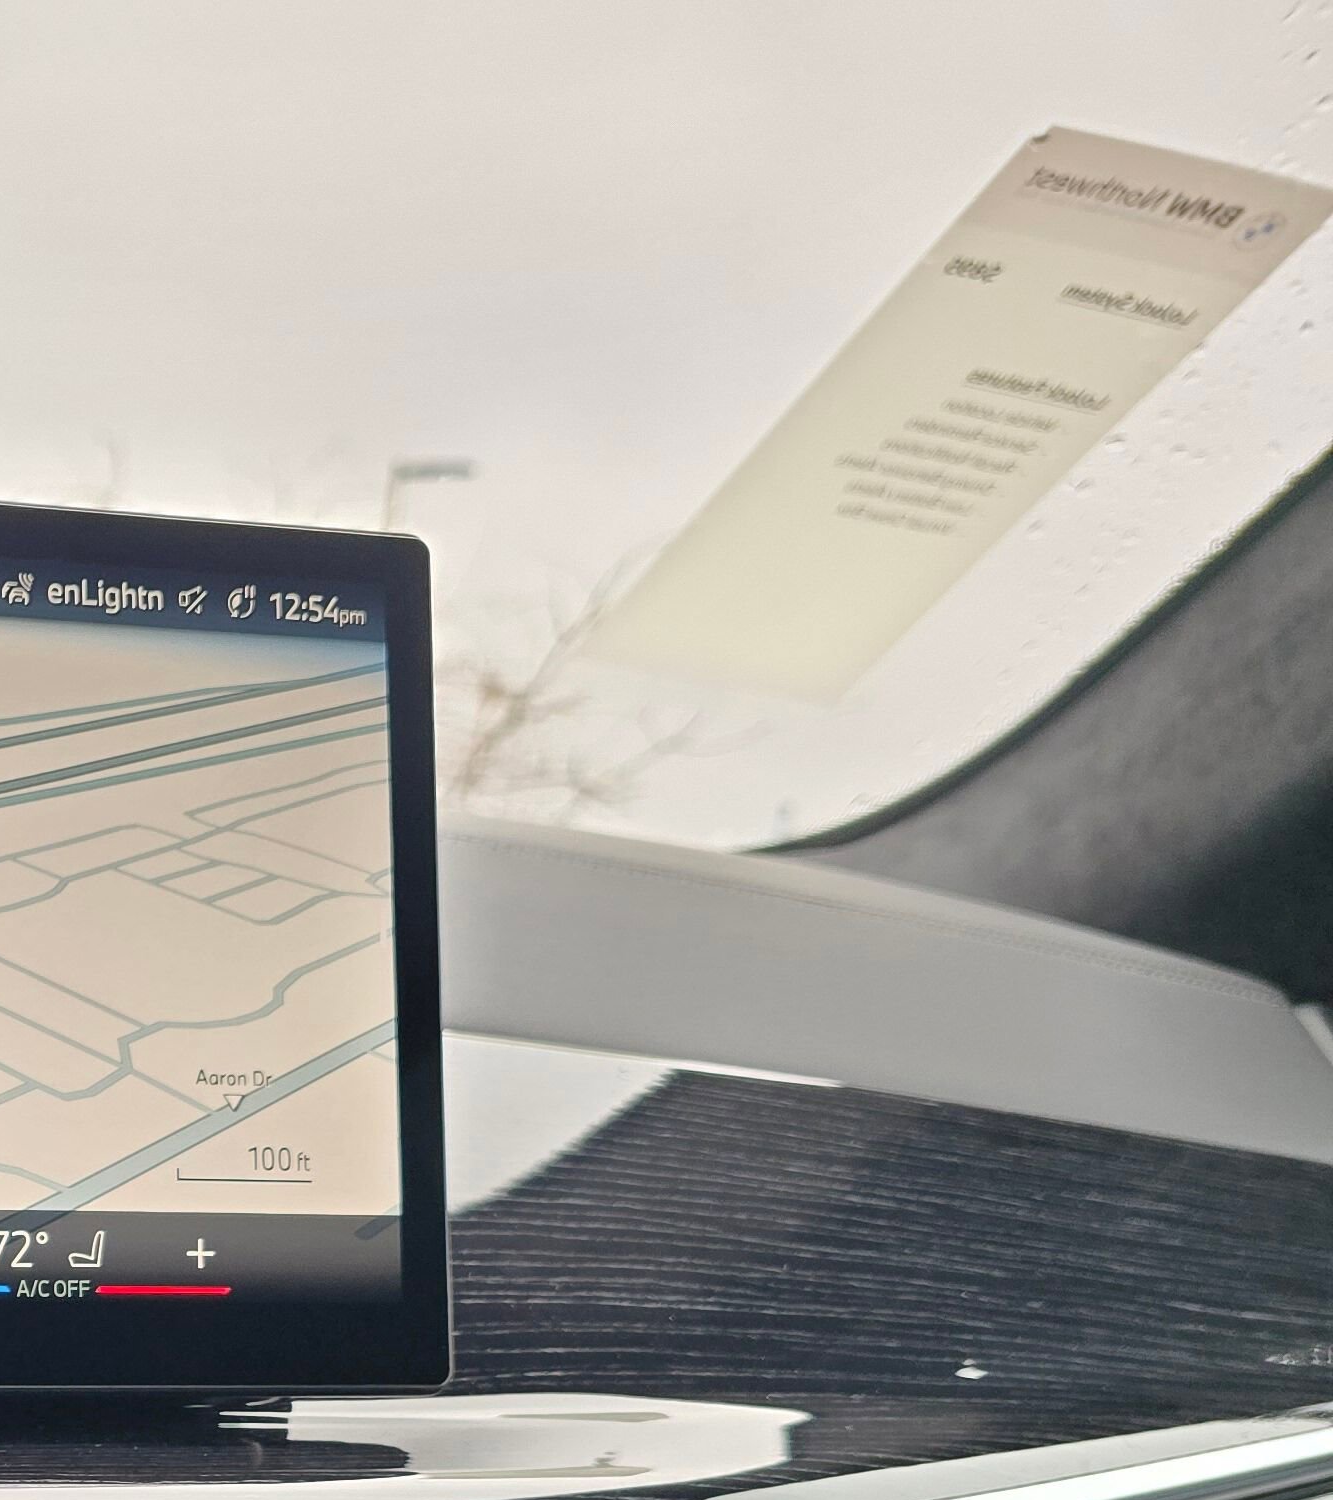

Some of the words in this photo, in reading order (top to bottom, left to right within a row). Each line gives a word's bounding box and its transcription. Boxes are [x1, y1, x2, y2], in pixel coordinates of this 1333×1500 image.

[47, 579, 164, 615] enLightn
[195, 1069, 247, 1086] Aaron
[253, 1071, 272, 1087] Dr
[248, 1147, 292, 1172] 100
[296, 1152, 311, 1172] ft
[16, 1280, 50, 1298] A/C
[53, 1279, 91, 1298] OFF
